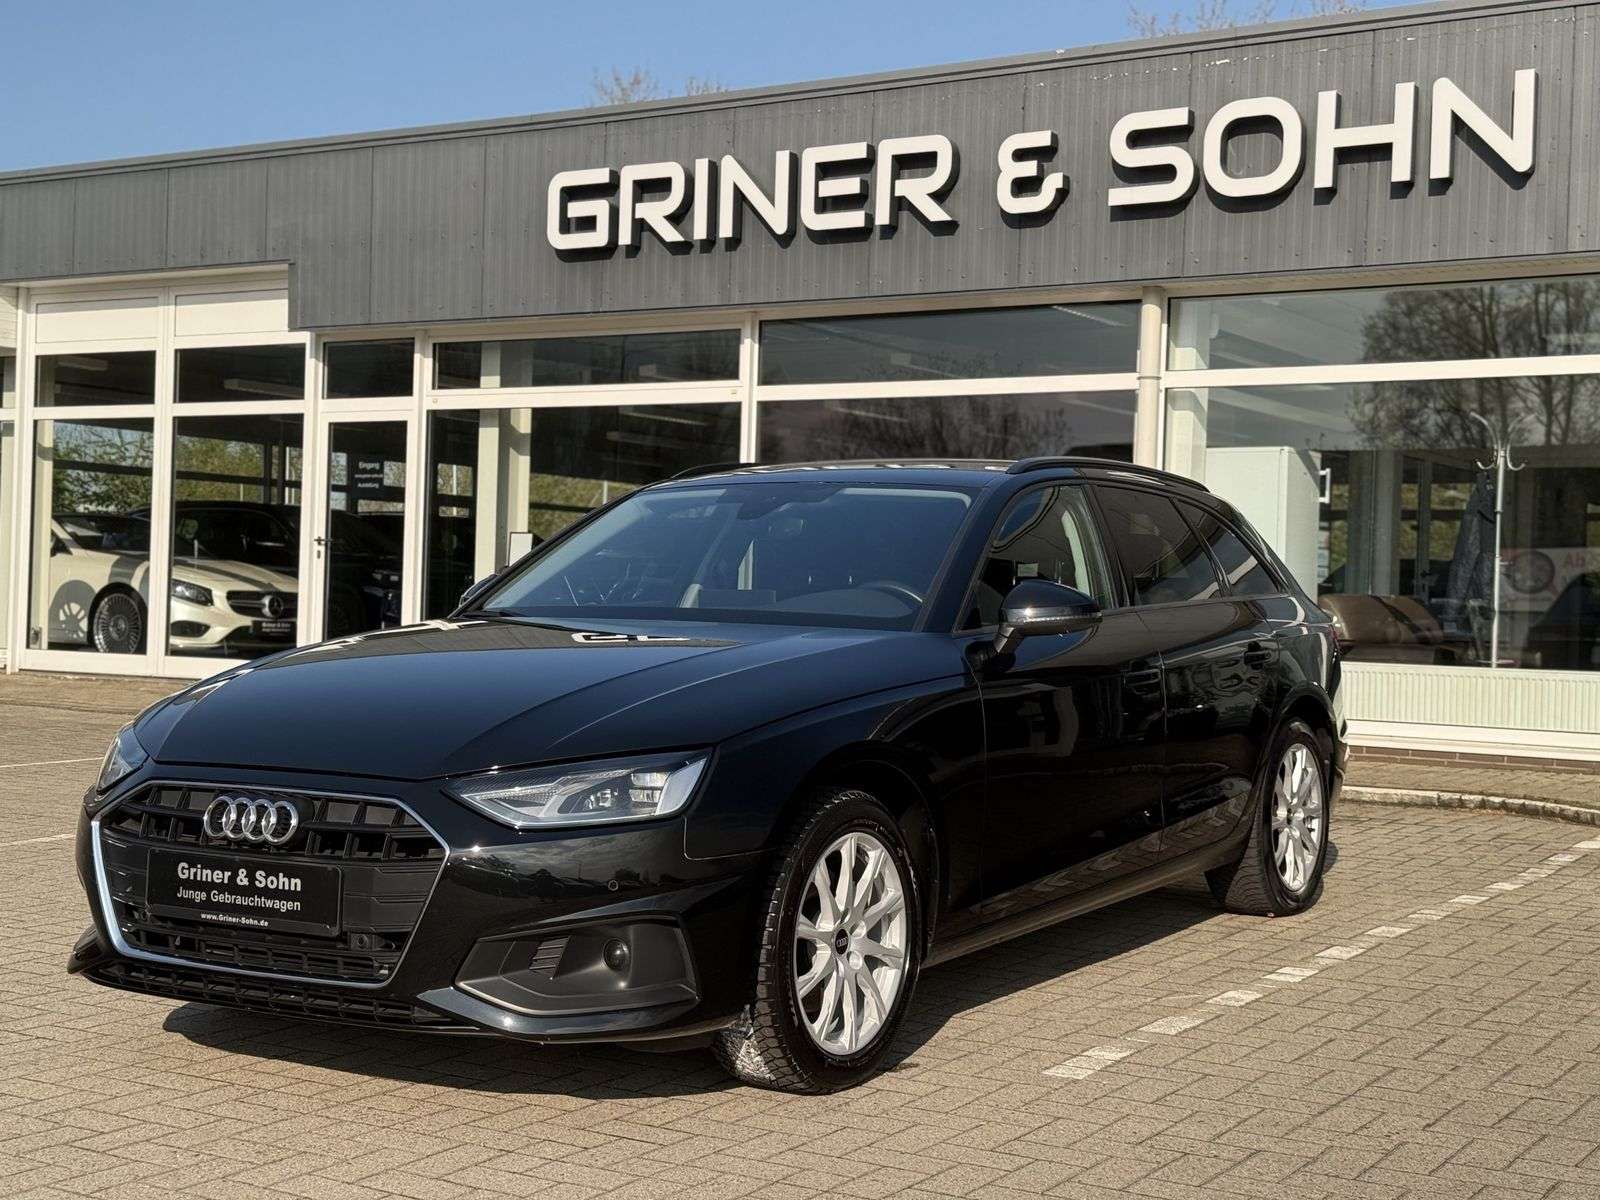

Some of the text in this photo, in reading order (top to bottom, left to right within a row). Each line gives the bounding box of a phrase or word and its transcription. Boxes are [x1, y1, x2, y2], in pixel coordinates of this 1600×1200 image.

[546, 68, 1537, 252] GRINER & SOHN
[177, 862, 302, 892] Griner & Sohn
[176, 886, 301, 913] Junge Gebrauchtwagen
[200, 912, 269, 927] www.Griner-Sohn.de
